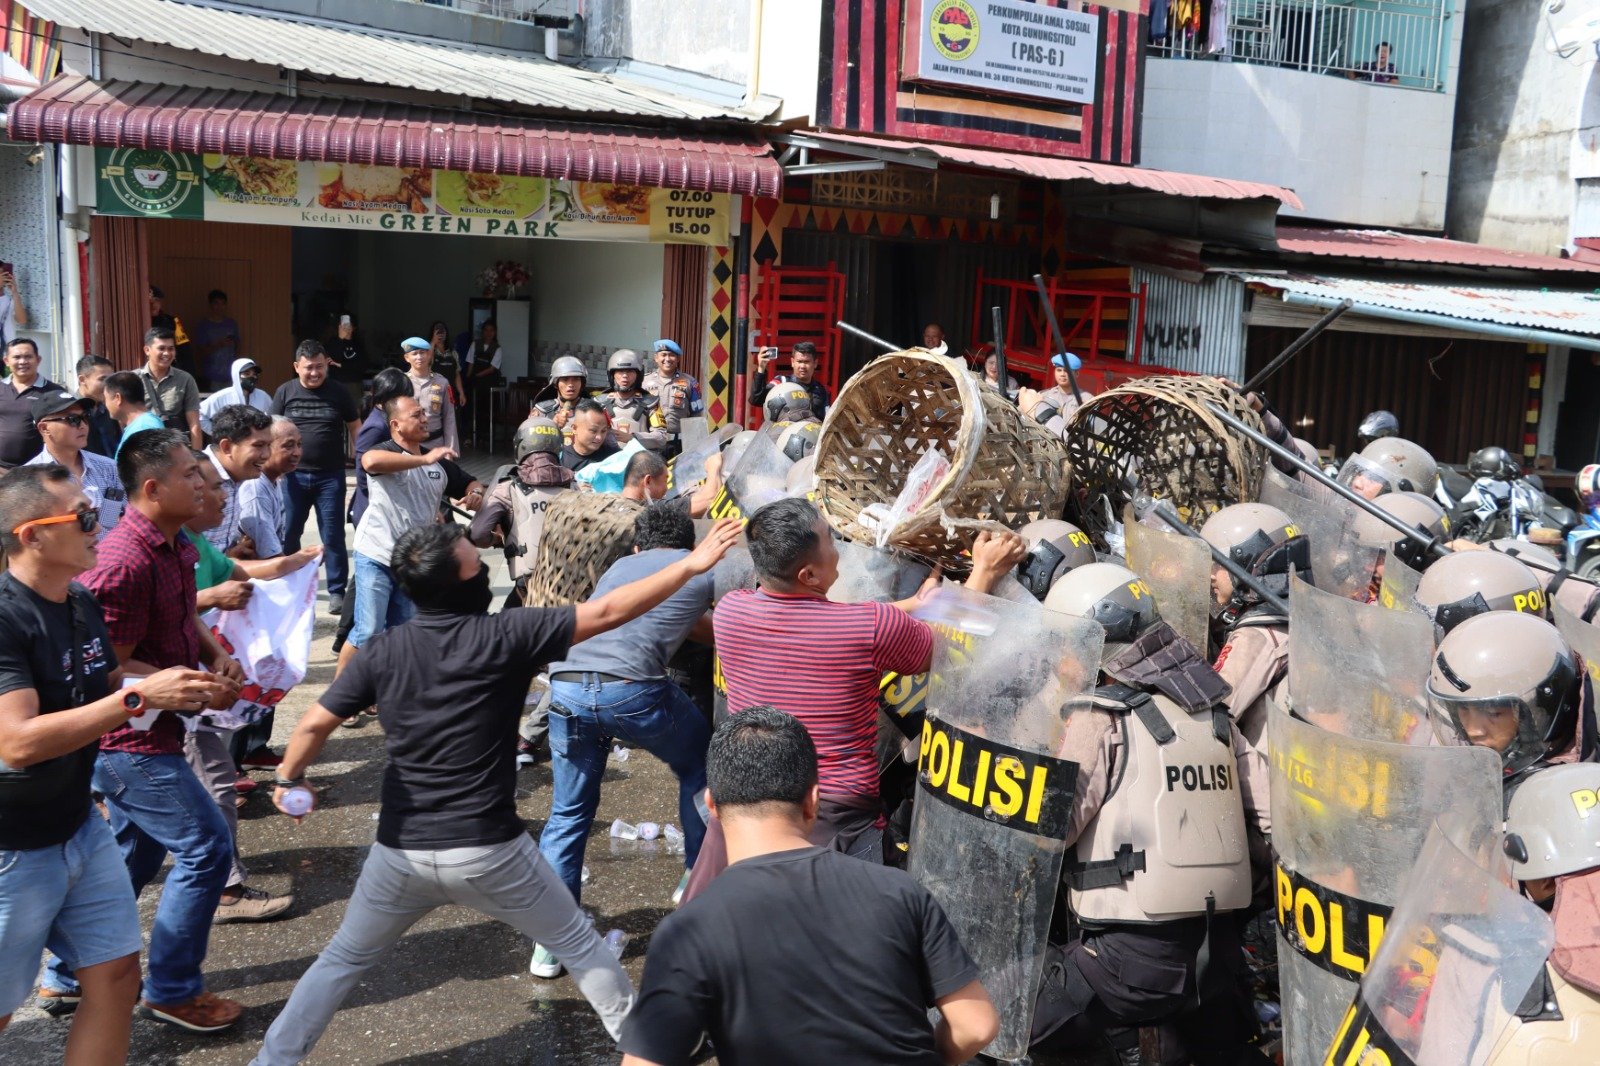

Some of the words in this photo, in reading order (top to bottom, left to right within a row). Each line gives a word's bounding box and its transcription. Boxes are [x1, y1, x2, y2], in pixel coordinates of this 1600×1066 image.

[988, 4, 1043, 24] PERKUMPULAN
[1044, 15, 1064, 29] AMAL
[1065, 19, 1091, 34] SOSIAL
[1001, 23, 1021, 36] KOTA
[1022, 26, 1076, 46] GUNUNGSITOLI
[1020, 42, 1057, 66] PAS-G
[932, 63, 949, 73] JALAN
[950, 66, 966, 75] PINTU
[966, 68, 983, 78] ANGIN
[670, 190, 713, 202] 07.00
[666, 206, 715, 218] TUTUP
[301, 211, 341, 223] Kedai
[347, 213, 373, 224] Mie
[380, 213, 471, 233] GREEN
[486, 218, 559, 238] PARK
[669, 222, 711, 235] 15.00
[1513, 588, 1546, 613] POL
[918, 719, 1048, 824] POLISI
[1165, 764, 1233, 792] POLISI
[1276, 863, 1388, 974] POLI
